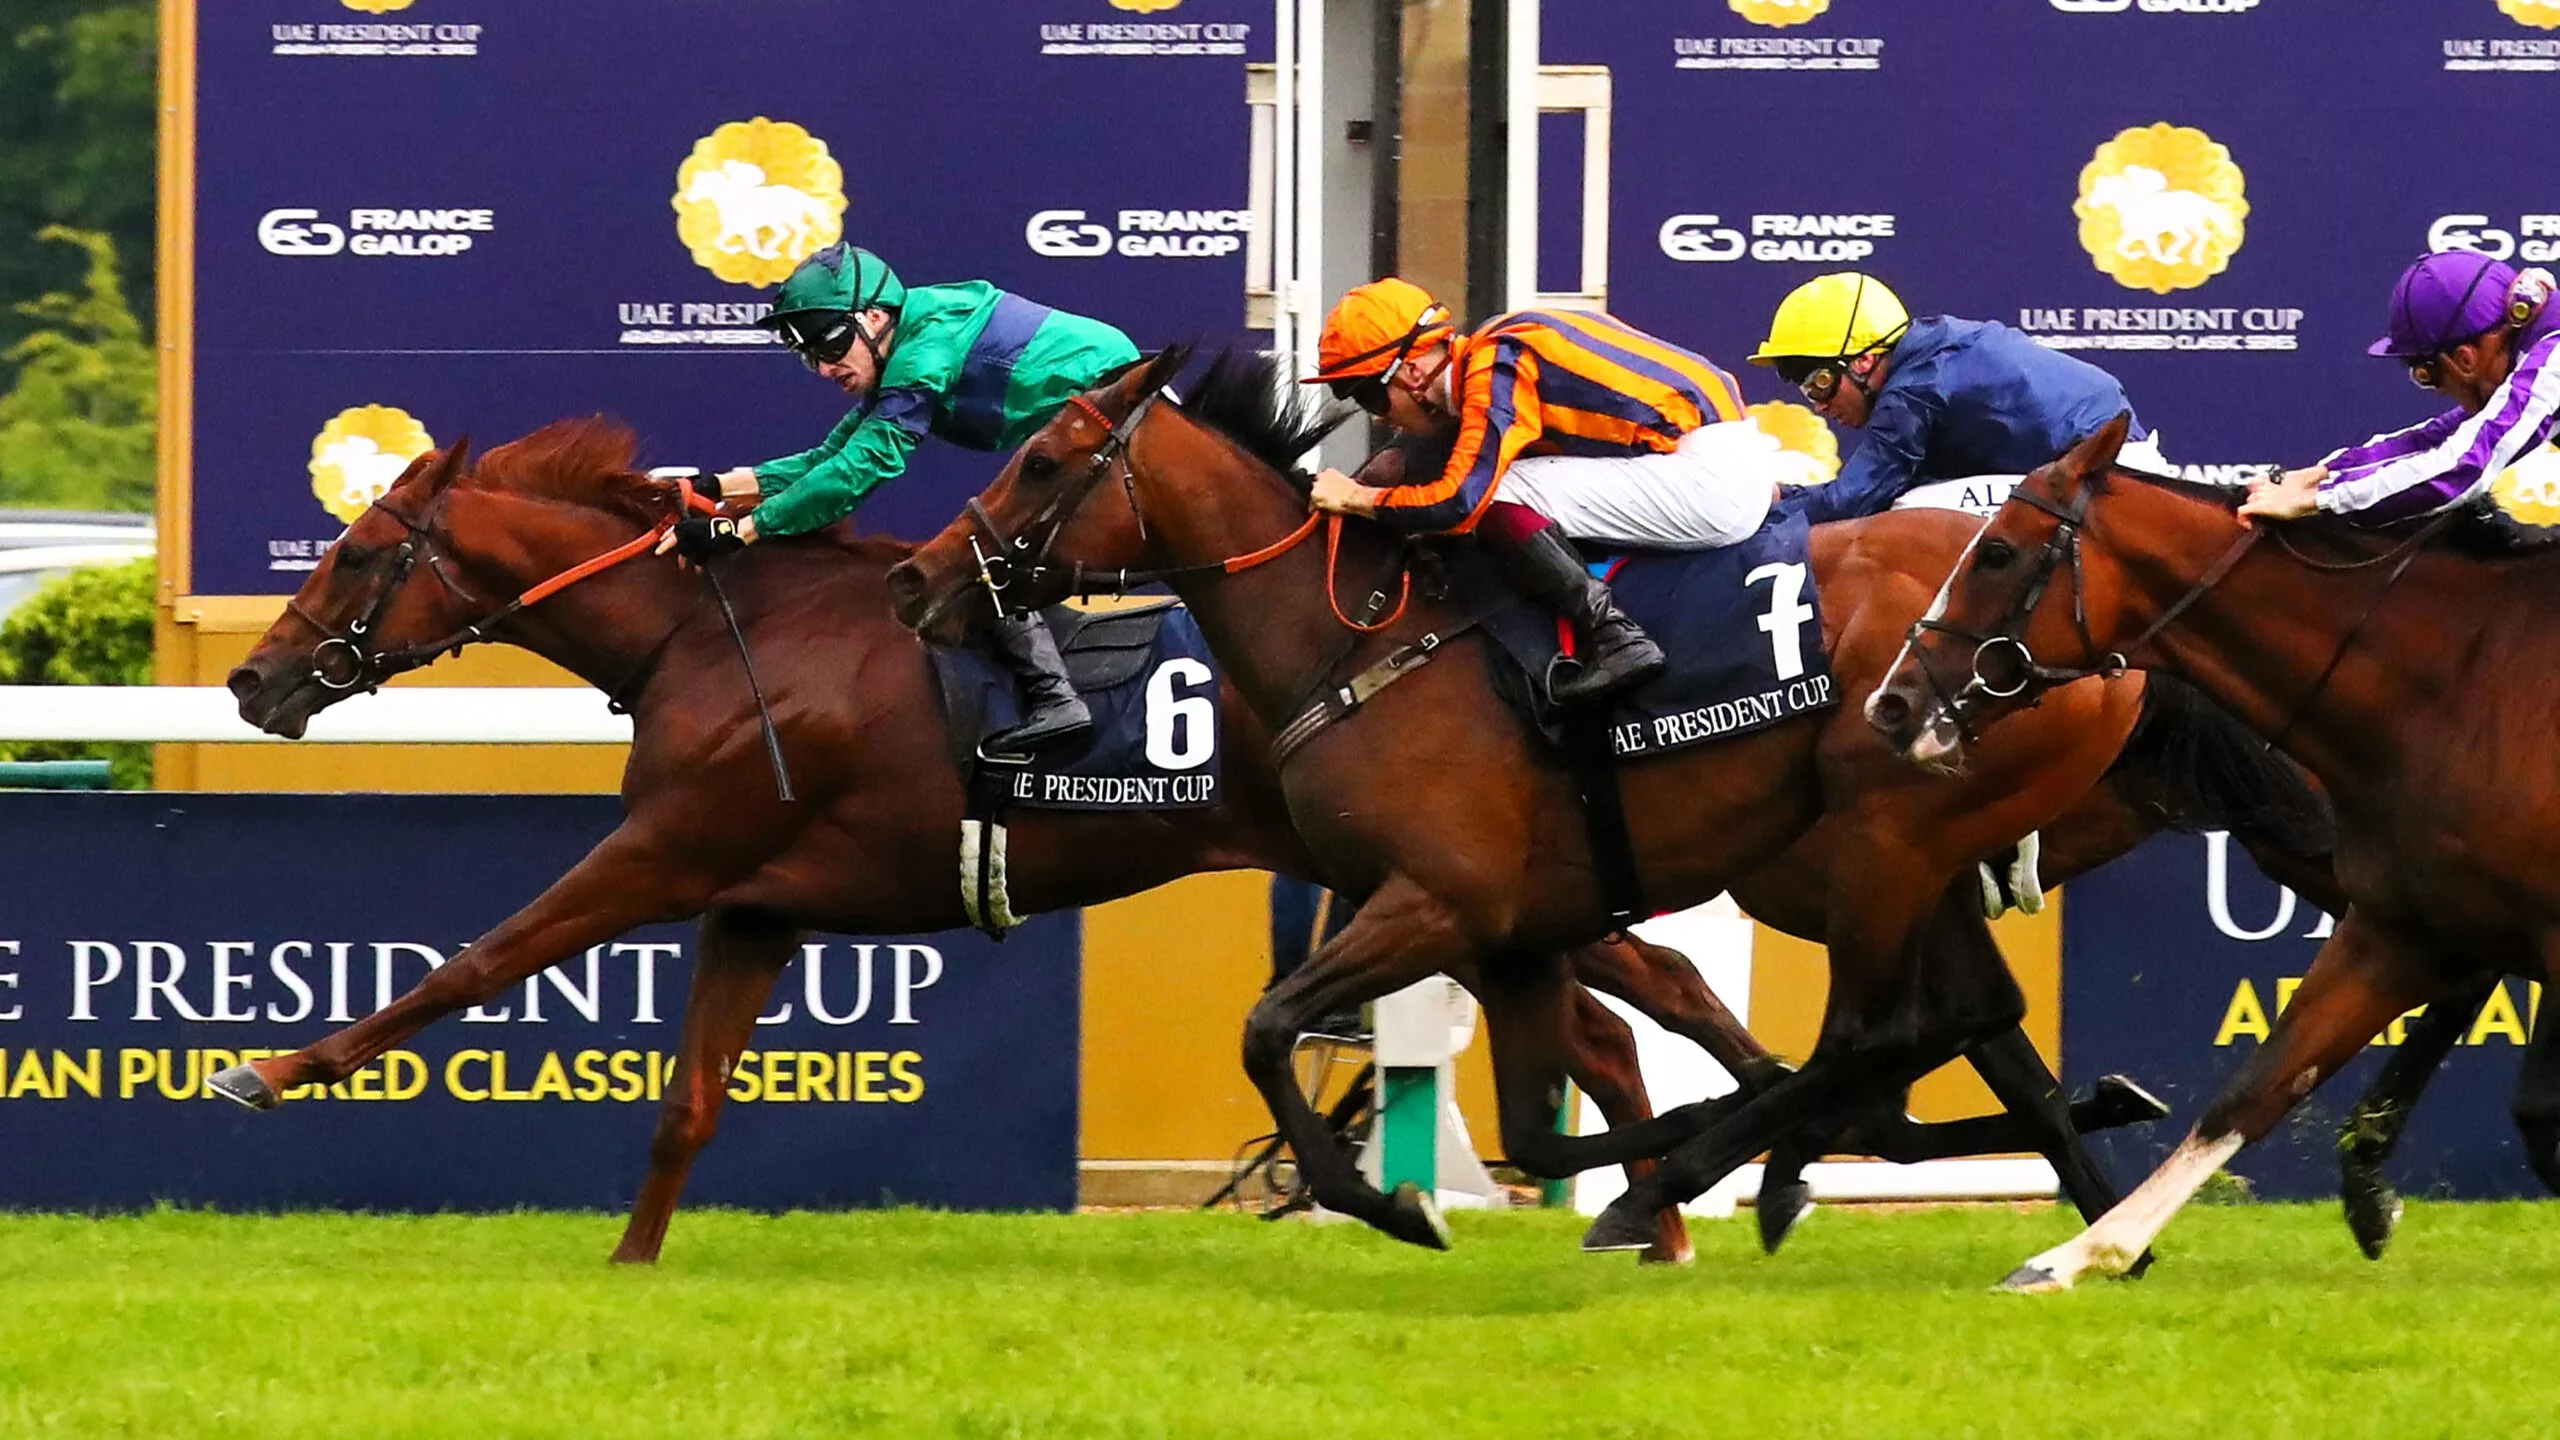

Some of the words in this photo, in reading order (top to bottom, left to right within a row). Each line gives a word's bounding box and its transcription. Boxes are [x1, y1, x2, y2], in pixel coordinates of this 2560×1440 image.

[350, 208, 494, 231] FRANCE
[1752, 214, 1896, 236] FRANCE
[349, 234, 473, 256] GALOP
[1117, 235, 1240, 257] GALOP
[1751, 240, 1873, 261] GALOP
[618, 302, 675, 325] UAE
[2019, 308, 2076, 331] UAE
[2083, 308, 2239, 331] PRESIDENT
[2241, 308, 2304, 331] CUP
[1744, 561, 1814, 681] 7
[1145, 657, 1215, 770] 6
[1653, 690, 1783, 746] PRESIDENT
[1788, 674, 1831, 711] CUP
[1044, 774, 1169, 804] PRESIDENT
[1172, 775, 1215, 802] CUP
[65, 939, 682, 1023] PRESIDNT
[726, 1050, 926, 1103] SERIES
